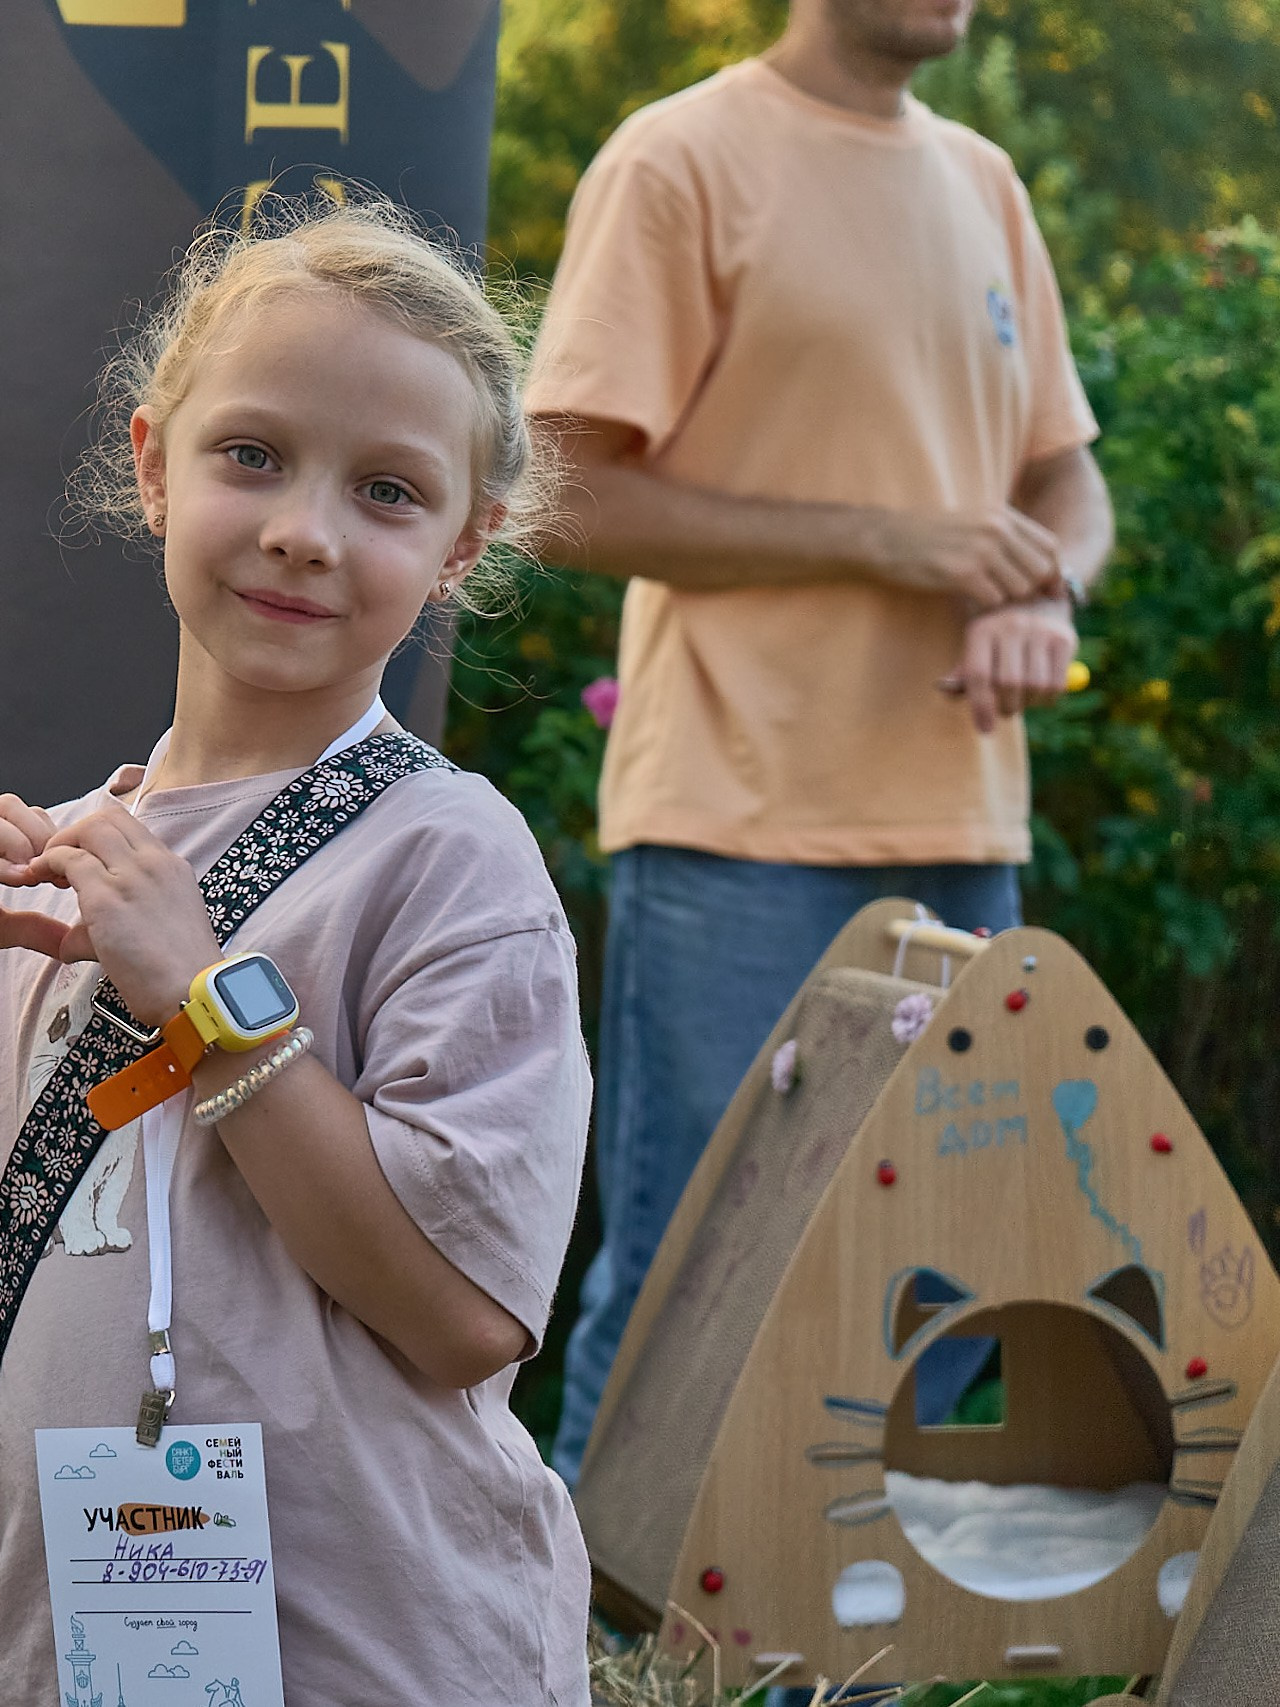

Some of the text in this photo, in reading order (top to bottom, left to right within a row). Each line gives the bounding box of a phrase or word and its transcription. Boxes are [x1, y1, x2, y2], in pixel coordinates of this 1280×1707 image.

[205, 1436, 241, 1448] СЕМЕЙ
[219, 1447, 242, 1458] НЫЙ
[207, 1459, 243, 1469] ФЕСТИ
[216, 1470, 244, 1480] ВАЛЬ
[83, 1506, 205, 1532] УЧАСТНИК
